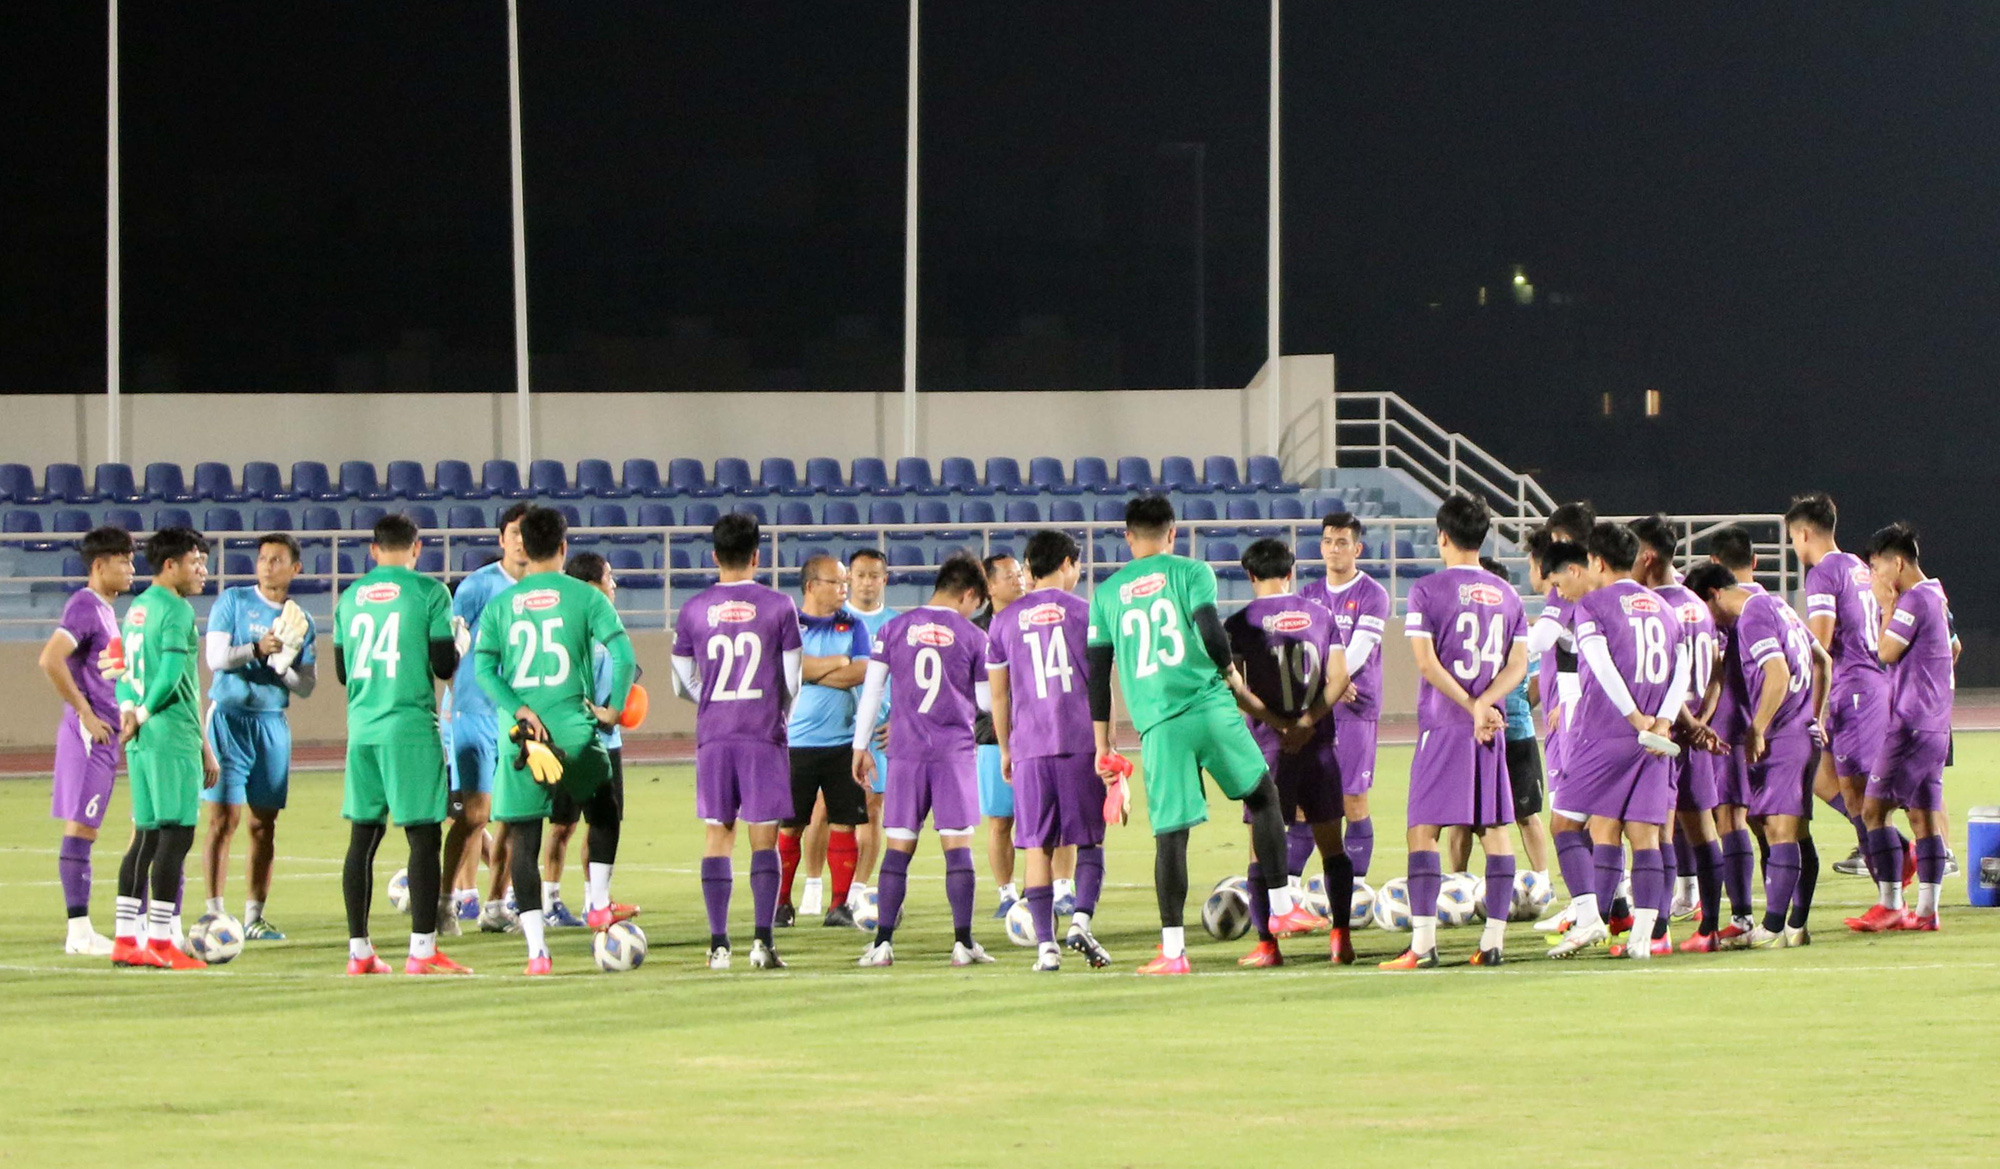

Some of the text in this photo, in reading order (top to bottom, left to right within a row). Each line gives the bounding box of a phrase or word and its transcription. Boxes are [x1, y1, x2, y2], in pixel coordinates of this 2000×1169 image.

[350, 612, 400, 679] 24
[509, 617, 570, 689] 25
[707, 631, 763, 701] 22
[1023, 625, 1073, 699] 14
[1122, 597, 1185, 679] 23
[1453, 611, 1503, 680] 34
[1628, 616, 1668, 685] 18
[914, 647, 942, 714] 9
[1271, 641, 1320, 711] 19
[85, 794, 100, 819] 6
